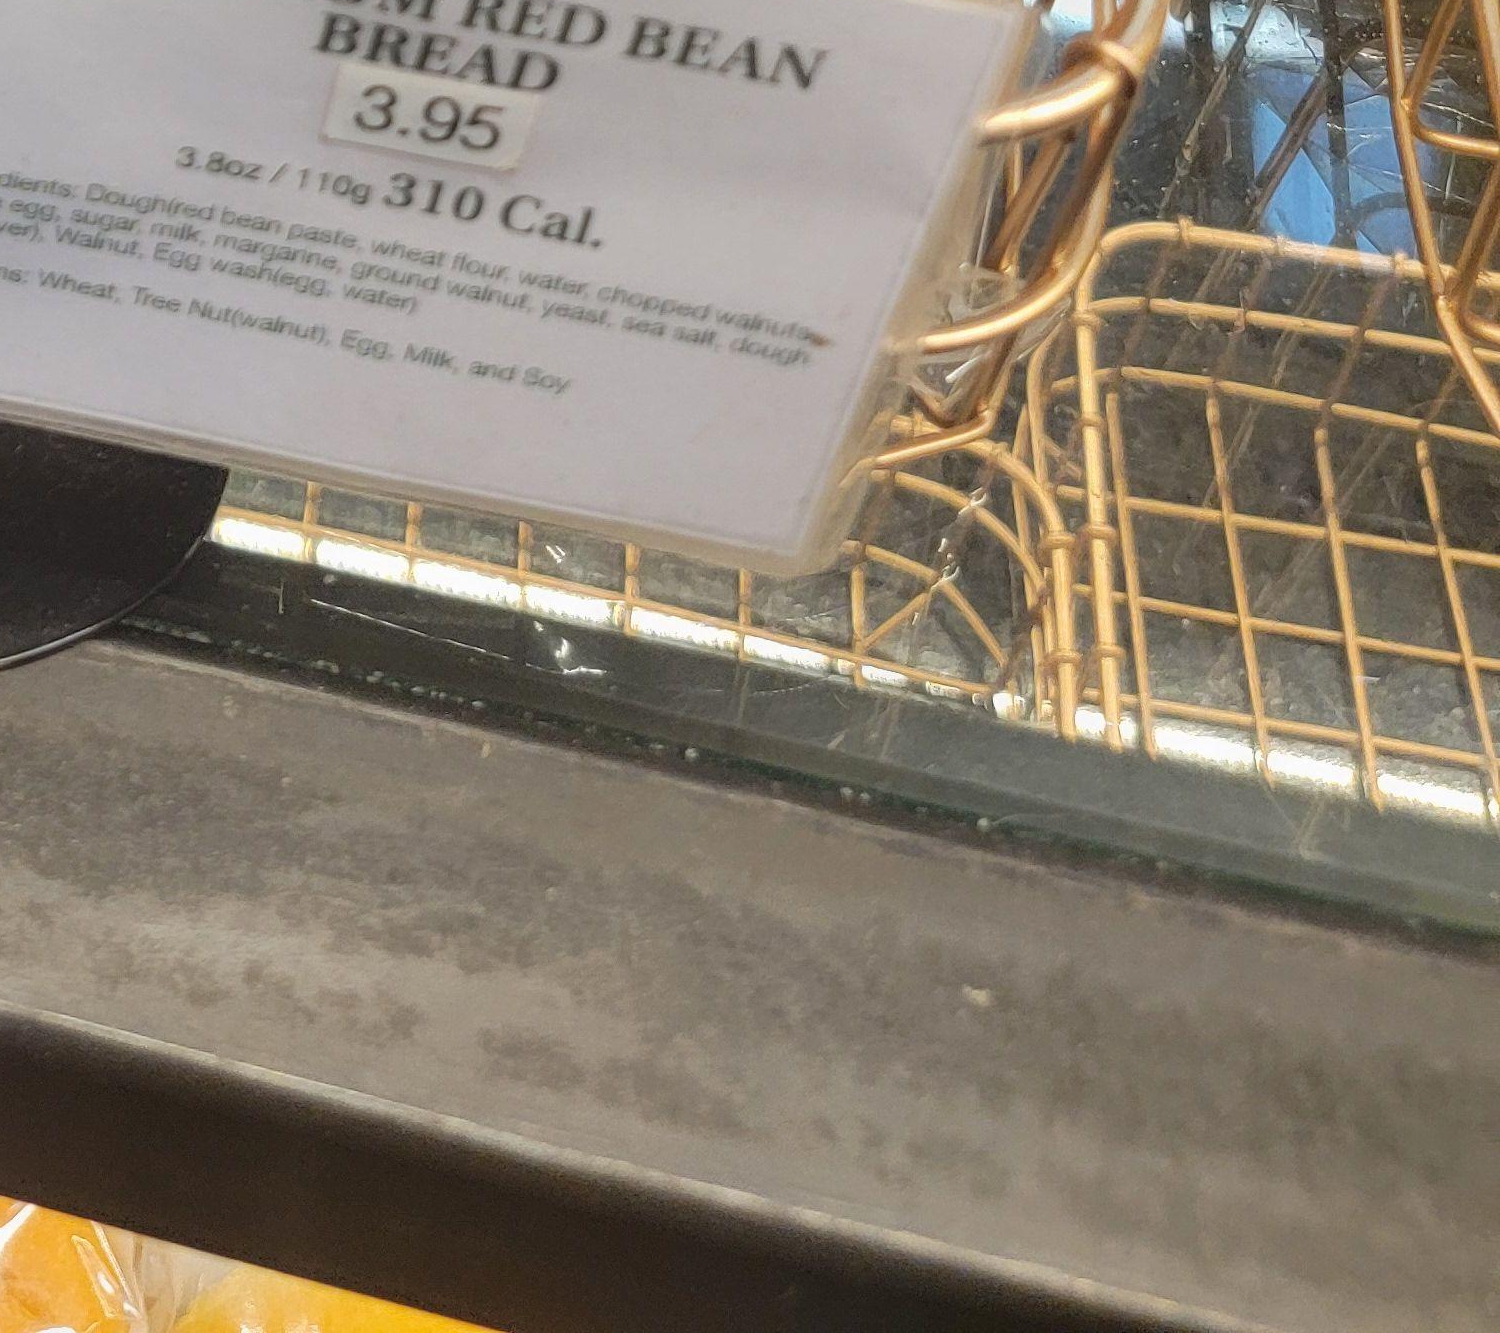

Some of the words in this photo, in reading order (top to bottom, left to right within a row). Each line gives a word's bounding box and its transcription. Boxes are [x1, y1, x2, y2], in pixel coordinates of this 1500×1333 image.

[313, 11, 564, 94] BREAD
[623, 15, 835, 92] BEAN
[352, 83, 508, 153] 3.95
[174, 144, 262, 183] 3.8oz
[267, 161, 285, 185] /
[297, 166, 373, 207] 110g
[381, 171, 486, 223] 310
[499, 193, 605, 250] Cal.
[9, 199, 61, 223] egg,
[150, 222, 206, 247] milk,
[213, 233, 342, 275] margarine,
[350, 260, 441, 292] ground
[447, 277, 533, 314] walnut,
[540, 298, 612, 328] yeast,
[620, 315, 667, 338] sea
[728, 335, 811, 367] dough
[55, 224, 144, 259] Walnut,
[152, 241, 202, 272] Egg
[210, 256, 332, 298] wash(egg,
[342, 280, 419, 314] water)
[85, 182, 215, 222] Dough(red
[219, 205, 283, 234] bean
[286, 221, 362, 253] paste,
[370, 236, 448, 268] wheat
[596, 285, 716, 322] chopped
[37, 268, 121, 304] Wheat,
[132, 284, 182, 313] Tree
[339, 327, 395, 360] Egg,
[402, 341, 458, 374] Milk,
[468, 359, 515, 381] and
[522, 365, 572, 396] Soy
